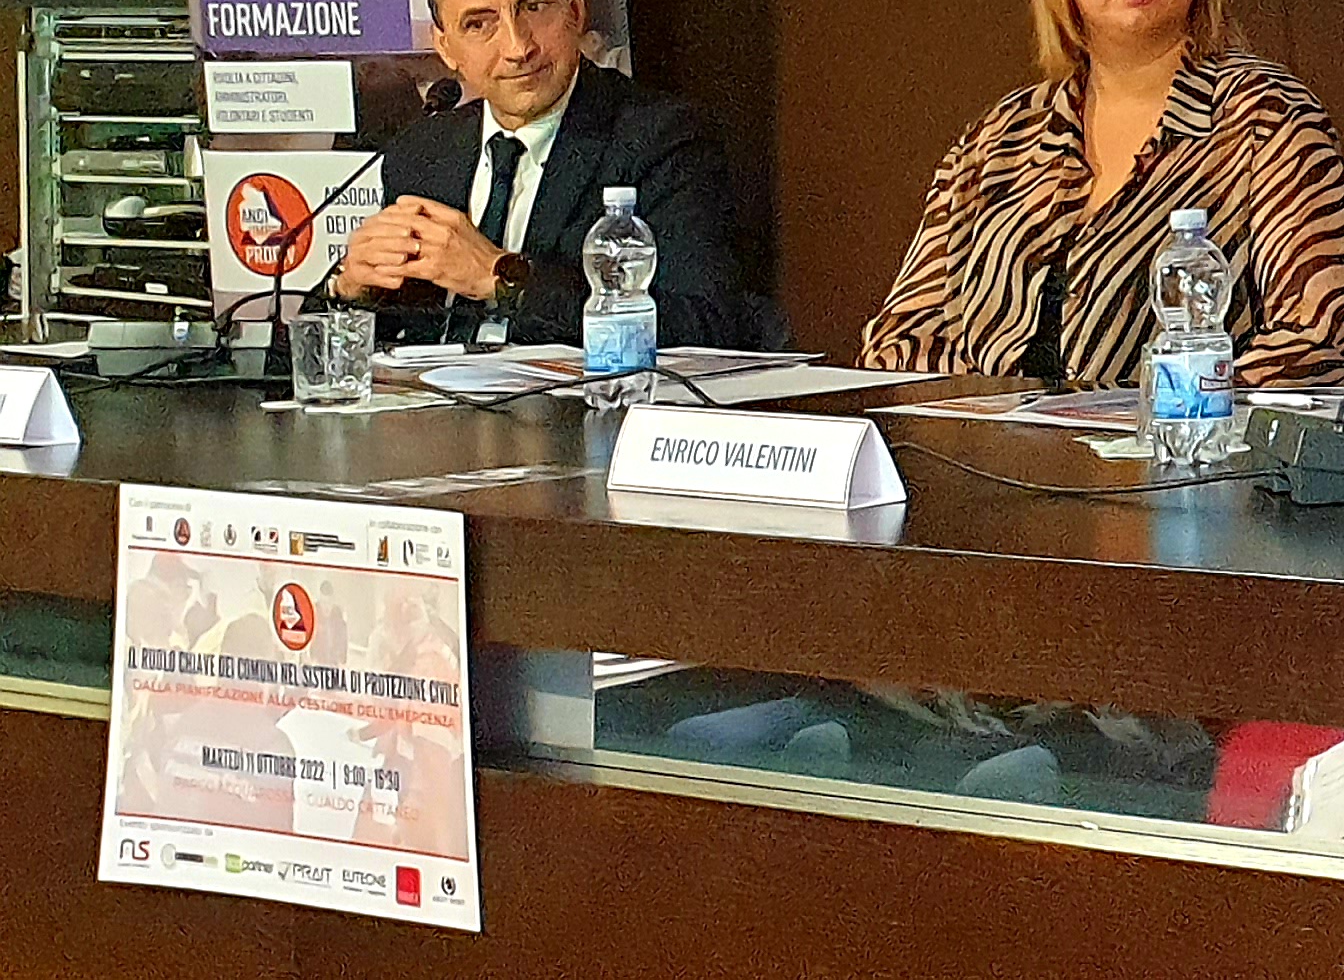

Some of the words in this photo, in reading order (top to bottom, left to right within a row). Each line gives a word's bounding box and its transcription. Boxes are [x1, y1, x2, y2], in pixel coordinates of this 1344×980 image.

[207, 1, 361, 36] FORMAZIONE
[324, 186, 384, 207] ASSOCIA
[242, 208, 269, 223] ANCI
[326, 215, 347, 234] DEI
[650, 437, 719, 466] ENRICO
[724, 442, 817, 473] VALENTINI
[128, 646, 137, 669] IL
[141, 647, 176, 673] RUOLO
[178, 651, 215, 677] CHIAVE
[218, 655, 235, 680] DEI
[237, 657, 278, 684] COMUNI
[280, 662, 300, 686] NEL
[302, 665, 347, 692] SISTEMA
[350, 670, 361, 694] DI
[364, 672, 426, 702] PROTEZIONE
[429, 679, 459, 707] CIVILE
[133, 679, 172, 693] DALLA
[267, 693, 296, 707] ALLA
[257, 753, 296, 778] OTTOBRE
[300, 758, 324, 782] 2022
[343, 764, 365, 786] 9:00
